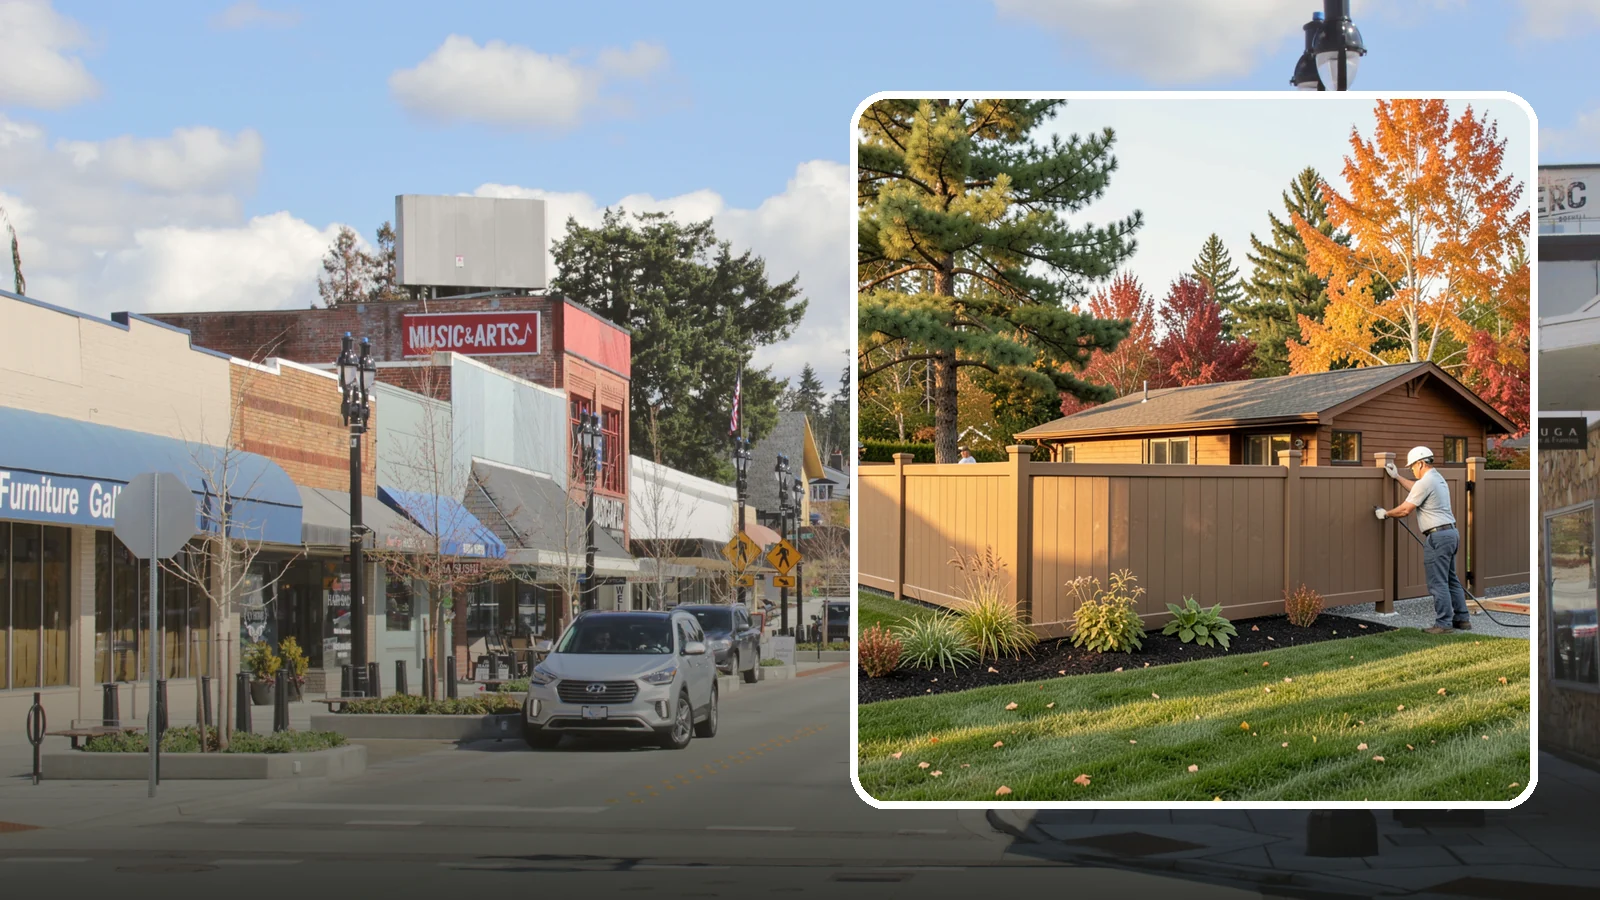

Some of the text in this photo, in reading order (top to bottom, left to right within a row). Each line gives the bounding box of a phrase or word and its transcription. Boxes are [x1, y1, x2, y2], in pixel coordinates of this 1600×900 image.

[0, 471, 122, 519] Furniture Gal
[454, 563, 479, 574] SUSHI
